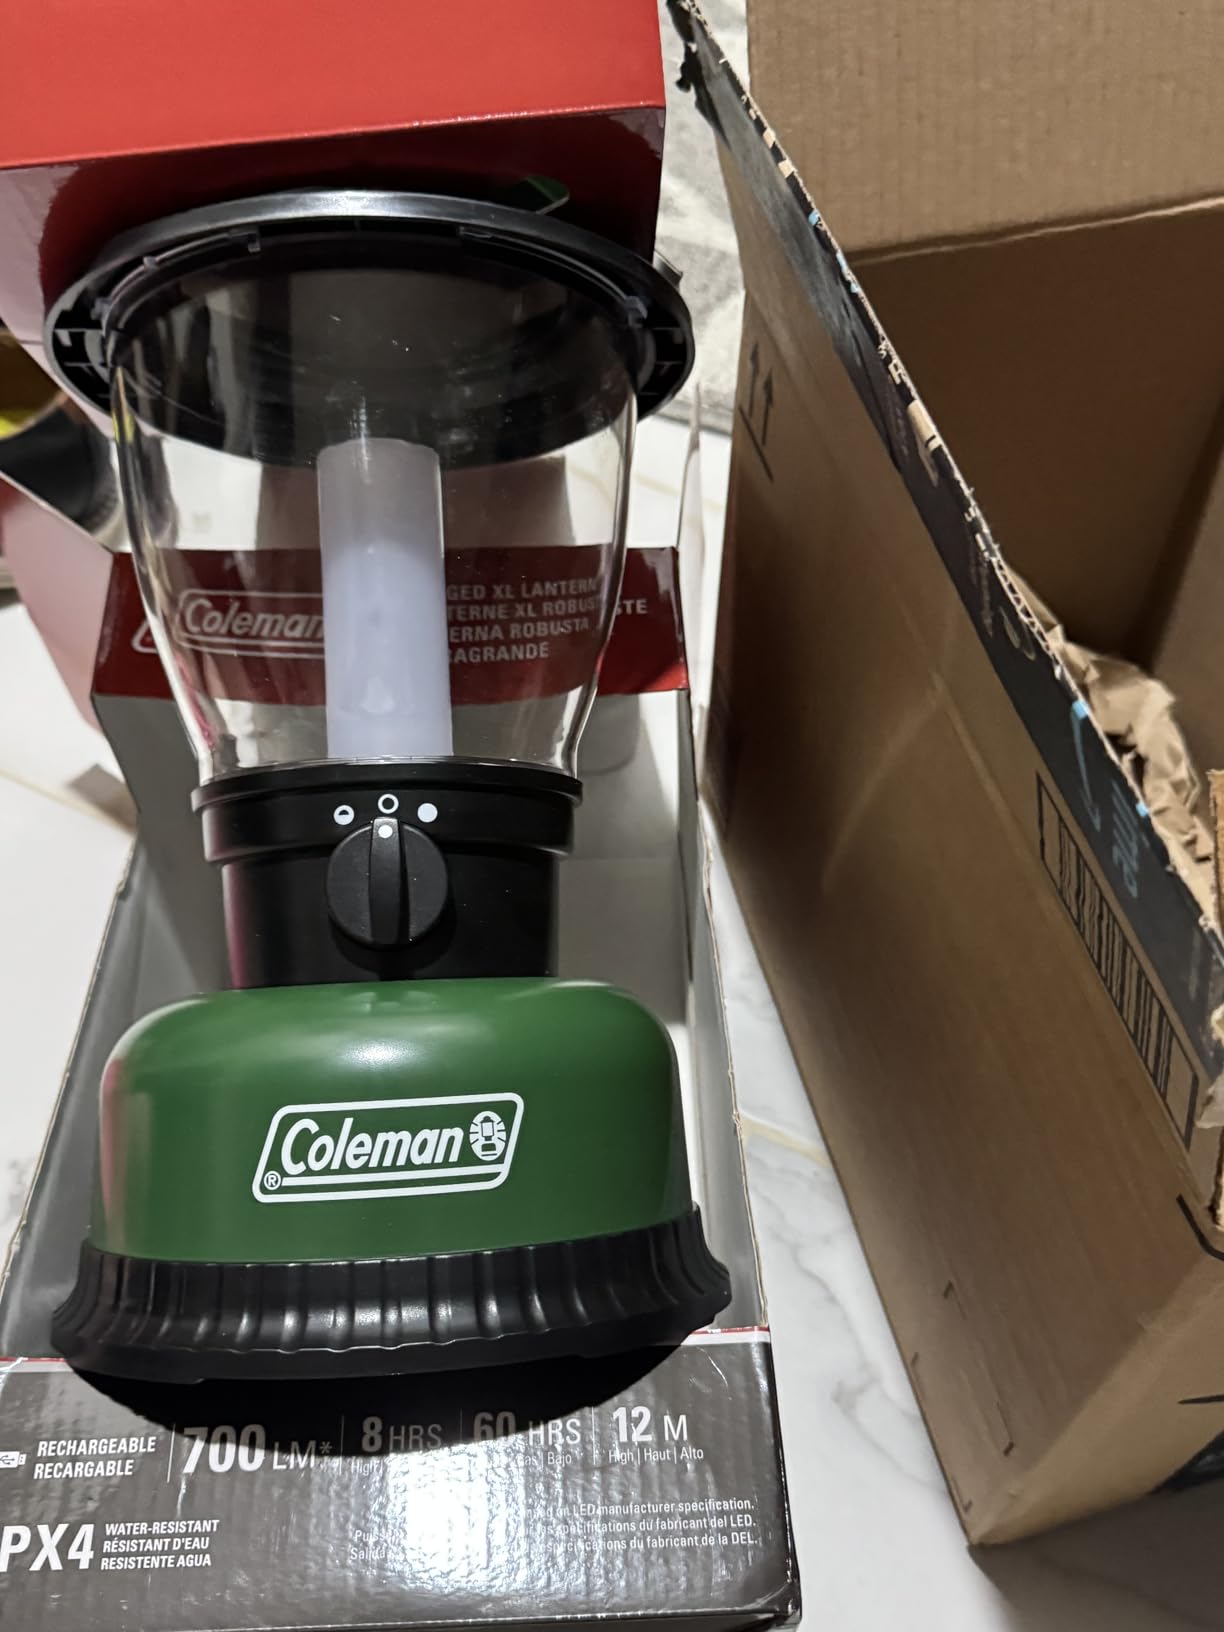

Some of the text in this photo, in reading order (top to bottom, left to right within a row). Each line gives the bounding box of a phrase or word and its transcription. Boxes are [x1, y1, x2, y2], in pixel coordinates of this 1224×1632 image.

[446, 578, 597, 600] GED XL LANTERN
[185, 598, 324, 638] Coleman
[447, 604, 511, 621] TERNE
[515, 602, 537, 617] XL
[449, 617, 589, 643] ERNA ROBUSTA
[449, 641, 550, 664] AGRANDE
[281, 1117, 464, 1175] Coleman
[361, 1416, 443, 1452] 8 HRS
[472, 1411, 582, 1446] 60 HRS
[612, 1405, 688, 1443] 12 M
[37, 1436, 157, 1457] RECHARGEABLE
[182, 1423, 266, 1474] 700
[608, 1446, 704, 1463] High Haut Alto
[33, 1459, 134, 1479] RECARGABLE
[547, 1452, 572, 1467] Bajo
[573, 1503, 595, 1516] LED
[599, 1501, 676, 1515] manufacturer
[678, 1497, 755, 1514] specification.
[105, 1519, 220, 1536] WATER-RESISTANT
[640, 1518, 653, 1531] du
[656, 1517, 707, 1530] fabricant
[710, 1515, 727, 1528] del
[730, 1514, 756, 1527] LED.
[0, 1523, 95, 1573] PX4
[102, 1536, 210, 1553] RÉSISTANT D'EAU
[630, 1536, 643, 1549] du
[647, 1535, 698, 1549] fabricant
[701, 1534, 715, 1546] de
[718, 1533, 728, 1545] la
[731, 1532, 758, 1544] DEL.
[100, 1553, 212, 1571] RESISTENTE AGUA
